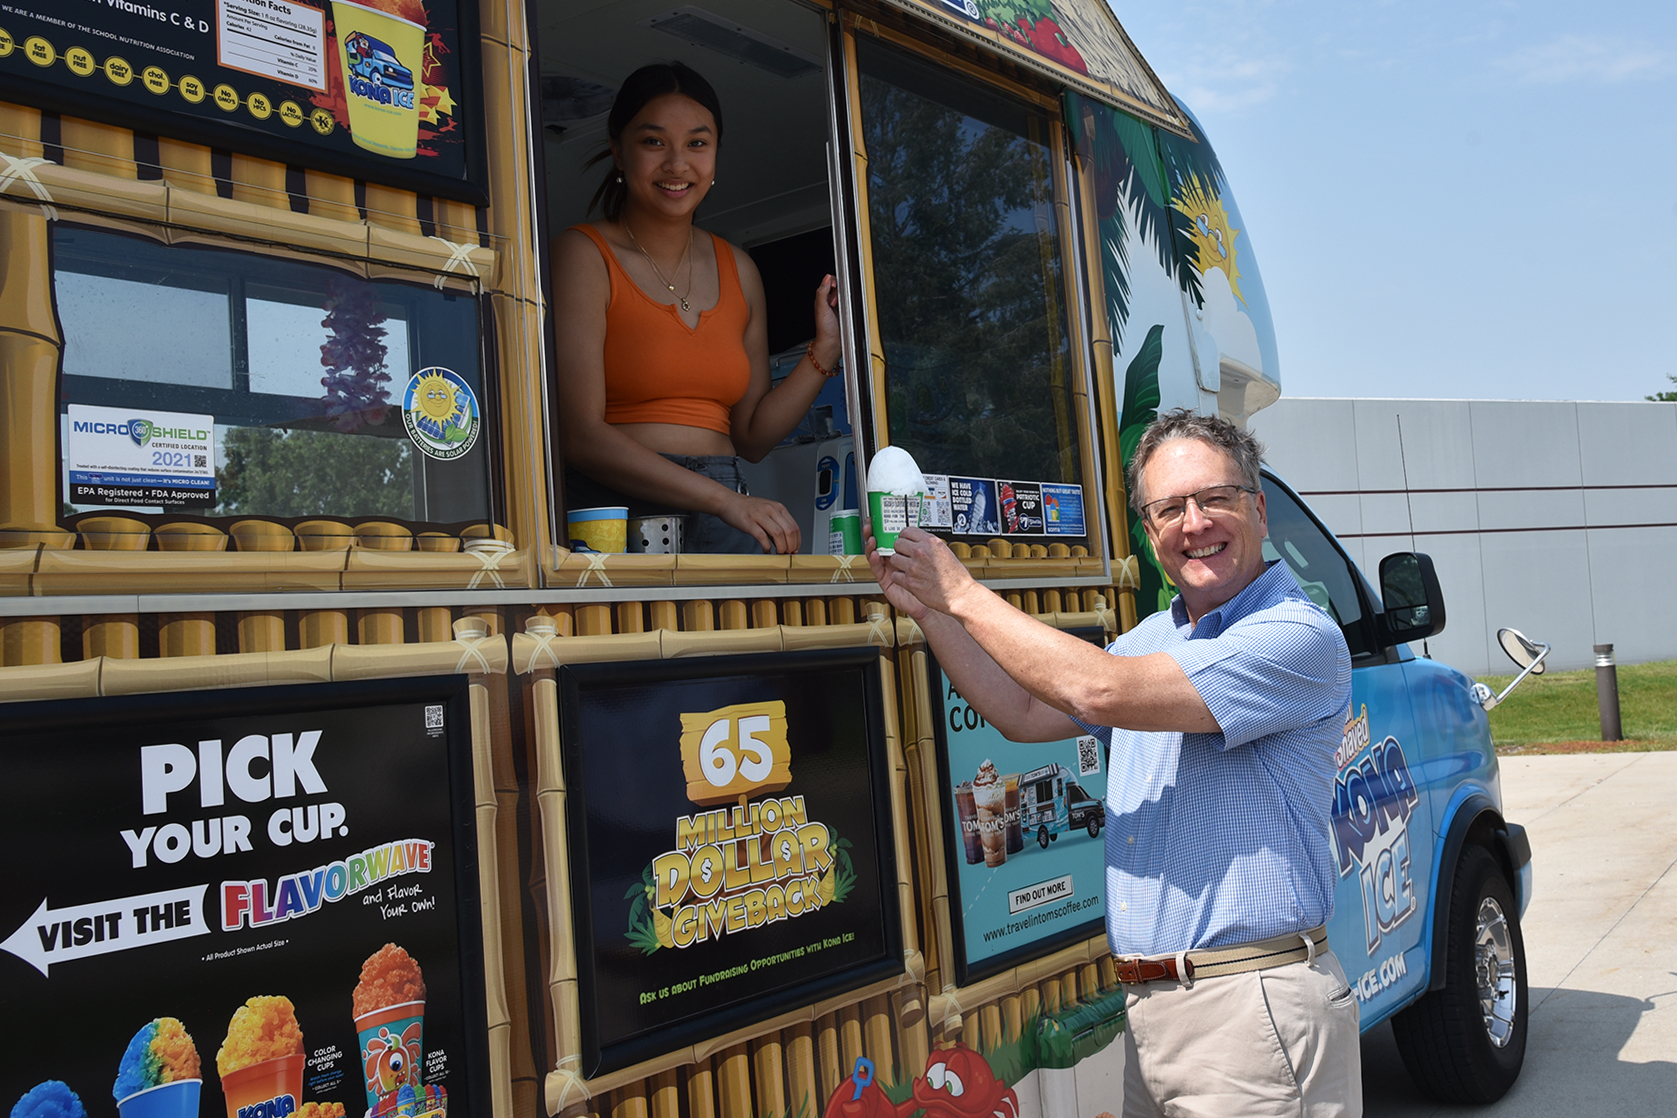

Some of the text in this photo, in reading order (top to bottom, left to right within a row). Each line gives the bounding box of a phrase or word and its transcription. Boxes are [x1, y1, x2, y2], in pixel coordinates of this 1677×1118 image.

[268, 1, 292, 15] Facts
[170, 12, 180, 26] C
[184, 16, 195, 30] &
[199, 20, 209, 33] D
[2, 4, 13, 13] WE
[14, 8, 28, 17] ARE
[36, 14, 66, 27] MEMBER
[78, 24, 90, 34] THE
[92, 28, 118, 40] SCHOOL
[119, 36, 155, 50] NUTRITION
[156, 46, 195, 60] ASSOCIATION
[34, 42, 46, 52] fat
[32, 50, 46, 60] FREE
[73, 54, 86, 62] nut
[73, 60, 87, 69] FREE
[110, 62, 128, 74] dairy
[112, 70, 126, 78] FREE
[148, 70, 165, 80] chol.
[150, 80, 163, 88] FREE
[186, 82, 198, 90] soy
[186, 88, 198, 96] FREE
[221, 90, 232, 98] No
[348, 74, 415, 110] KONA ICE
[254, 98, 264, 106] No
[286, 106, 296, 114] No
[74, 421, 129, 436] MICRO
[152, 427, 207, 440] SHIELD
[405, 414, 414, 430] OUR
[410, 429, 434, 454] BATTERIES
[434, 448, 445, 458] ARE
[446, 446, 464, 458] SOLAR
[152, 442, 179, 450] CERTIFIED
[152, 452, 191, 467] 2021
[959, 482, 972, 490] HAVE
[78, 487, 210, 500] EPA Registered FDA Approved
[1022, 501, 1036, 510] CUP
[700, 715, 773, 787] 65
[140, 729, 328, 815] PICK
[1329, 734, 1419, 878] KONA
[676, 795, 808, 852] MILLION
[981, 816, 1004, 833] TOM'S
[120, 802, 349, 869] YOUR CUP.
[652, 822, 833, 909] DOLLAR
[220, 838, 432, 932] FLAVORWAVE
[1360, 826, 1414, 955] ICE
[362, 888, 382, 905] and
[1016, 881, 1066, 906] FIND OUT MORE
[671, 876, 822, 949] GIVEBACK
[982, 895, 1099, 942] www.travelintomscoffee.com
[37, 899, 192, 952] VISIT THE
[206, 939, 285, 961] All Product Shown Actual Size
[1352, 952, 1407, 1002] -ICE.COM
[314, 1045, 336, 1057] COLOR
[428, 1049, 444, 1059] KONA
[308, 1051, 342, 1066] CHANGING
[426, 1055, 448, 1067] FLAVOR
[317, 1060, 334, 1072] CUPS
[429, 1063, 444, 1073] CUPS
